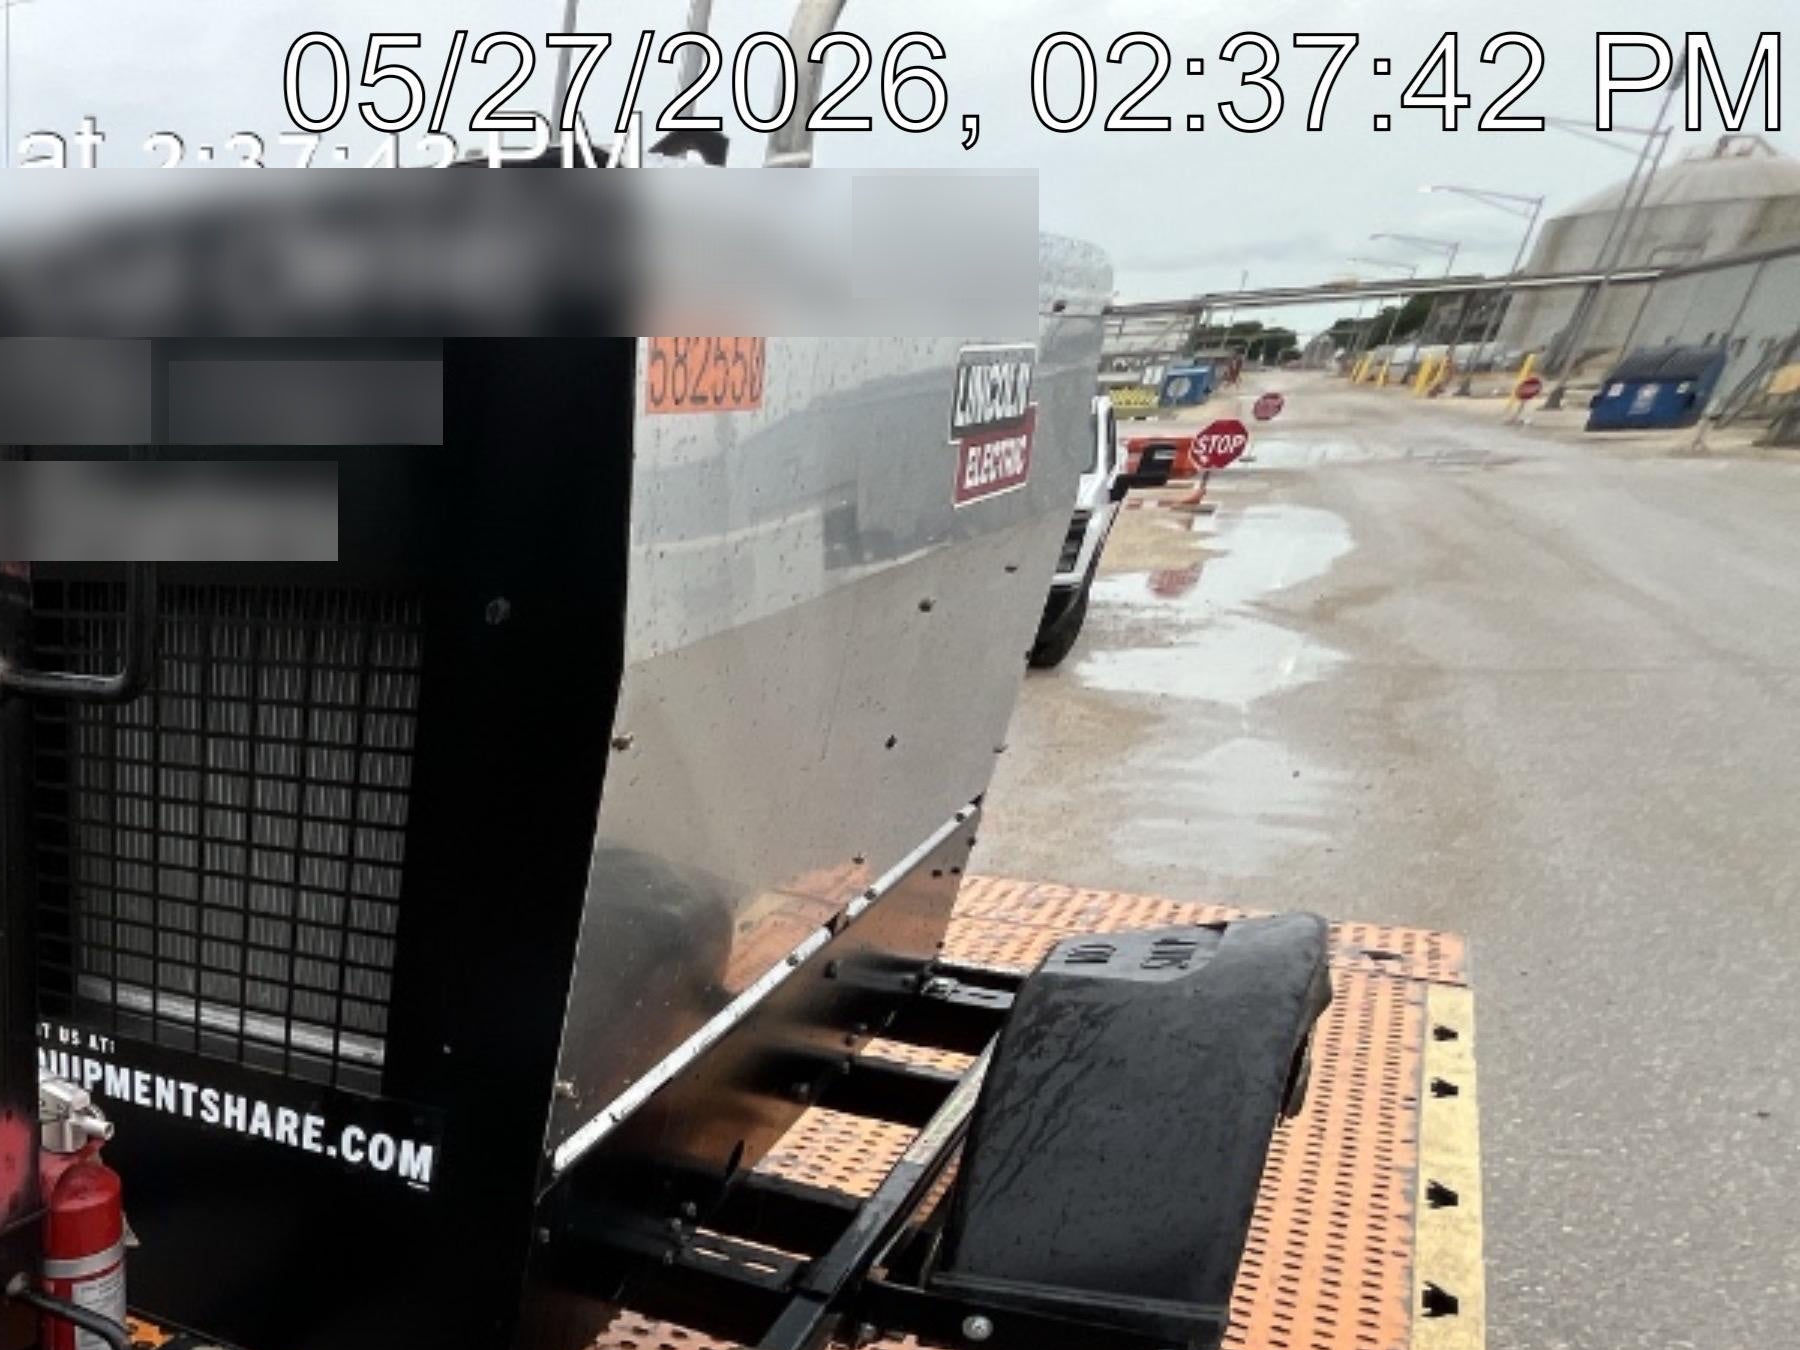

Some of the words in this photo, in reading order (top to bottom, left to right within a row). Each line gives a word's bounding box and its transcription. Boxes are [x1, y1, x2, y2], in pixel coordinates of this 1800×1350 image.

[954, 362, 1032, 427] LINCOLN
[963, 434, 1028, 489] ELECTRIC
[1193, 433, 1245, 455] STOP
[58, 1025, 81, 1046] US
[38, 1046, 433, 1183] UIPMENTSHARE.COM
